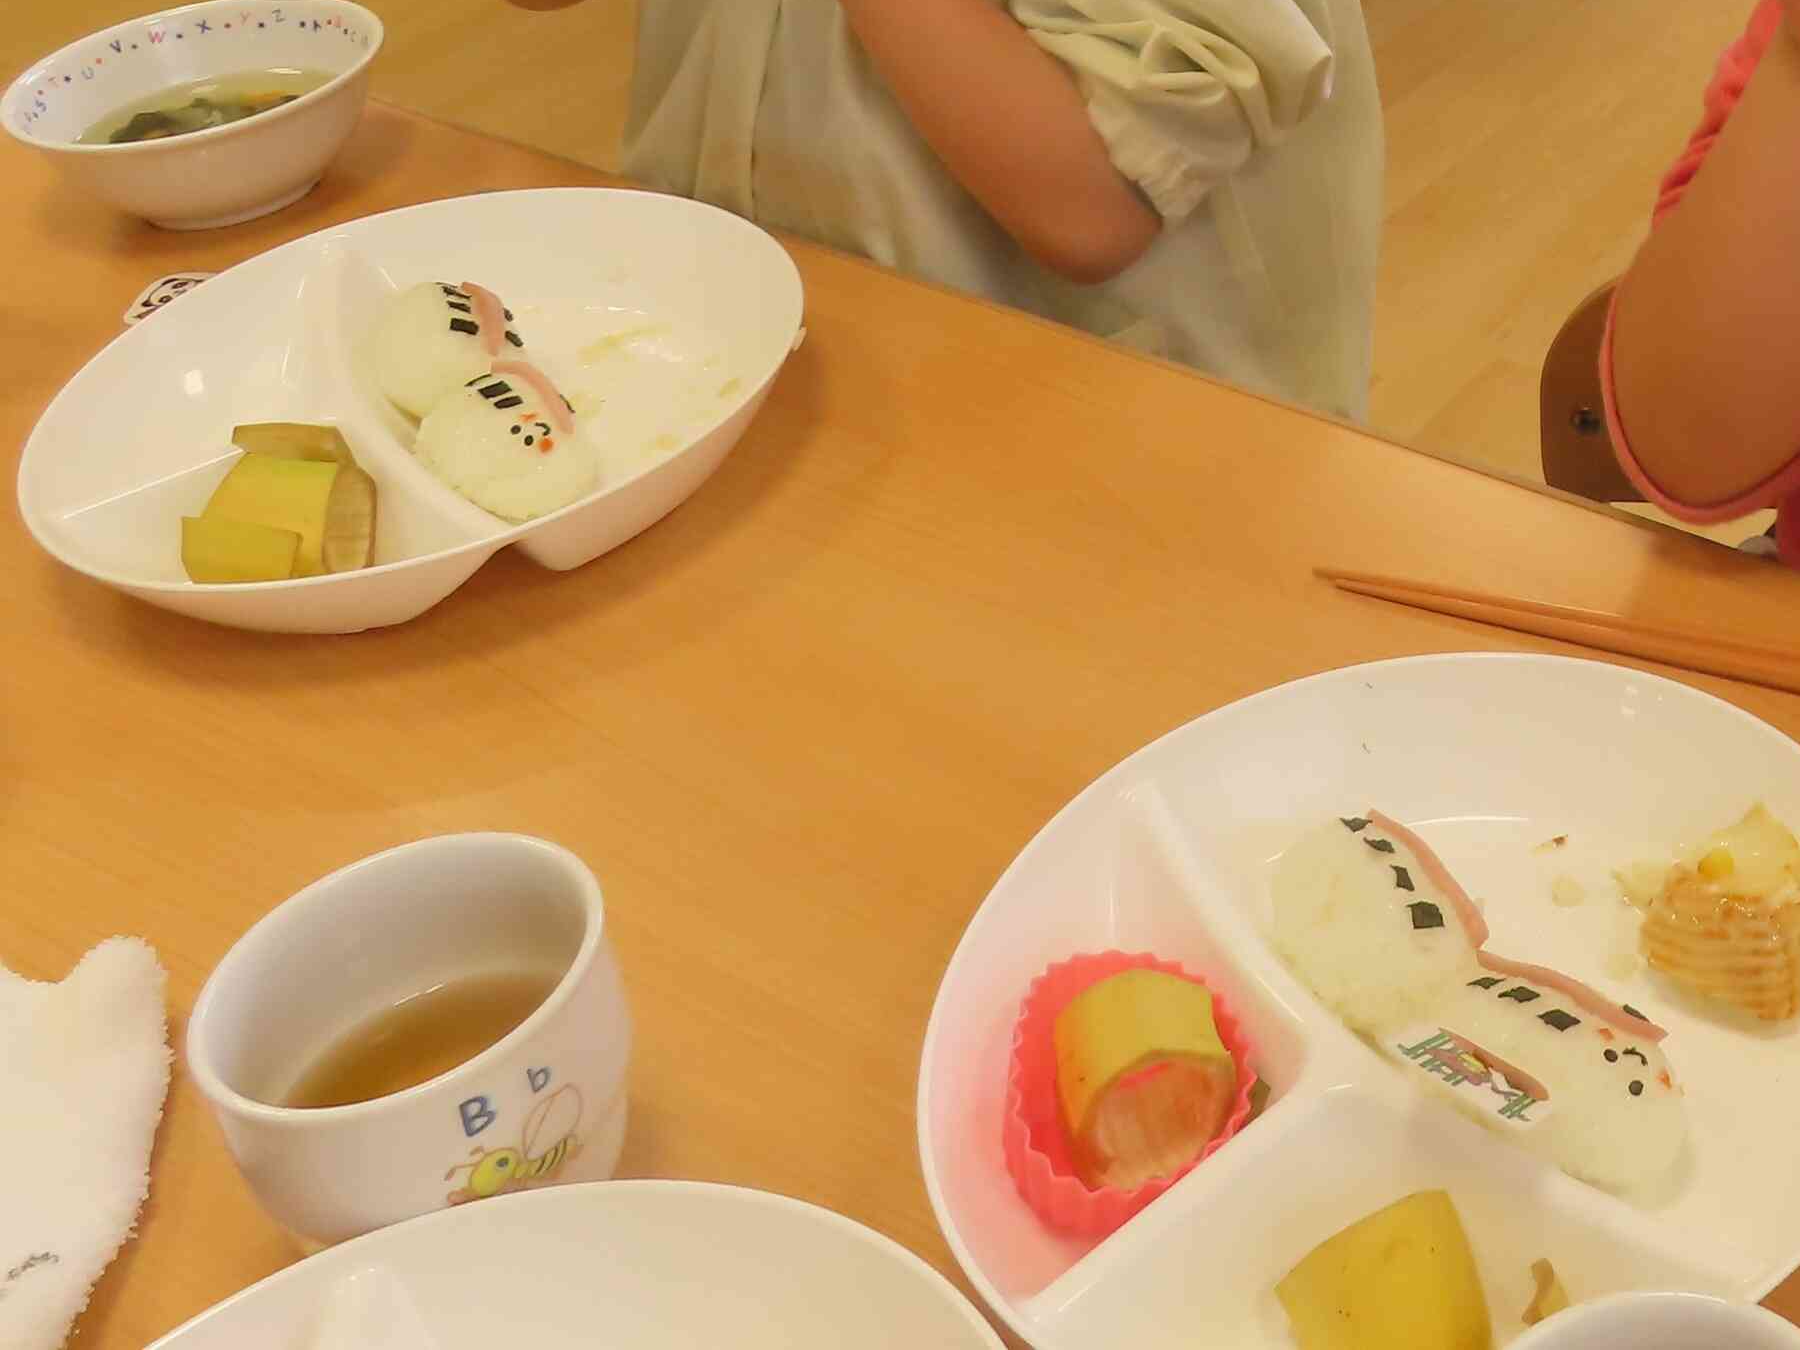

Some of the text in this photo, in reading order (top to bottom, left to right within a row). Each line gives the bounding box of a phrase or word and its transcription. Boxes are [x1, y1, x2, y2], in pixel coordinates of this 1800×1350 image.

[110, 39, 122, 53] V
[148, 30, 167, 44] W
[195, 19, 212, 34] X
[272, 9, 286, 23] Z
[459, 1067, 551, 1137] B b
